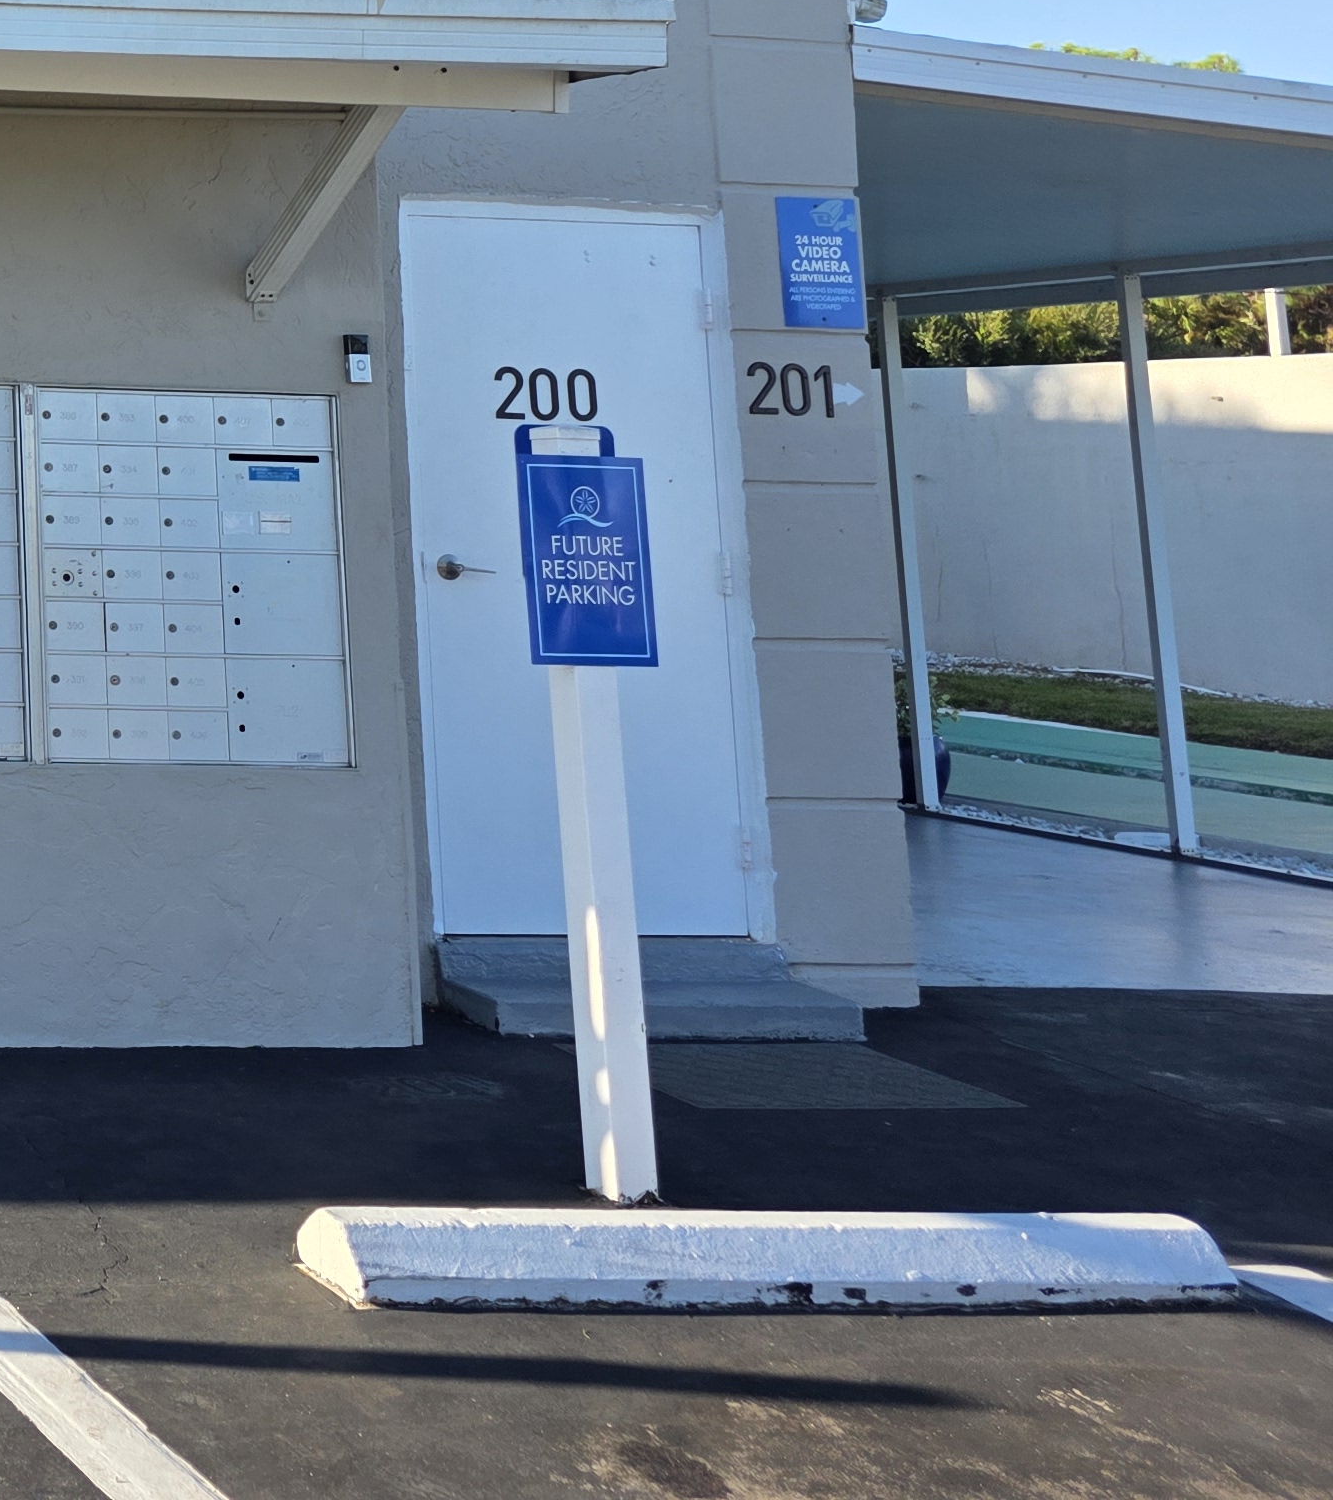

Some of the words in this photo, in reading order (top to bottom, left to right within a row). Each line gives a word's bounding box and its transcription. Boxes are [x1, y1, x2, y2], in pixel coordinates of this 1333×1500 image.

[795, 235, 809, 245] 24
[811, 236, 843, 246] HOUR
[798, 246, 841, 259] VIDEO
[791, 259, 850, 273] CAMERA
[790, 273, 853, 283] SURVEILLANCE
[493, 366, 598, 422] 200
[746, 362, 835, 418] 201
[62, 463, 79, 473] 387
[551, 535, 624, 557] FUTURE
[541, 559, 636, 581] RESIDENT
[546, 585, 635, 606] PARKING
[66, 621, 85, 631] 390
